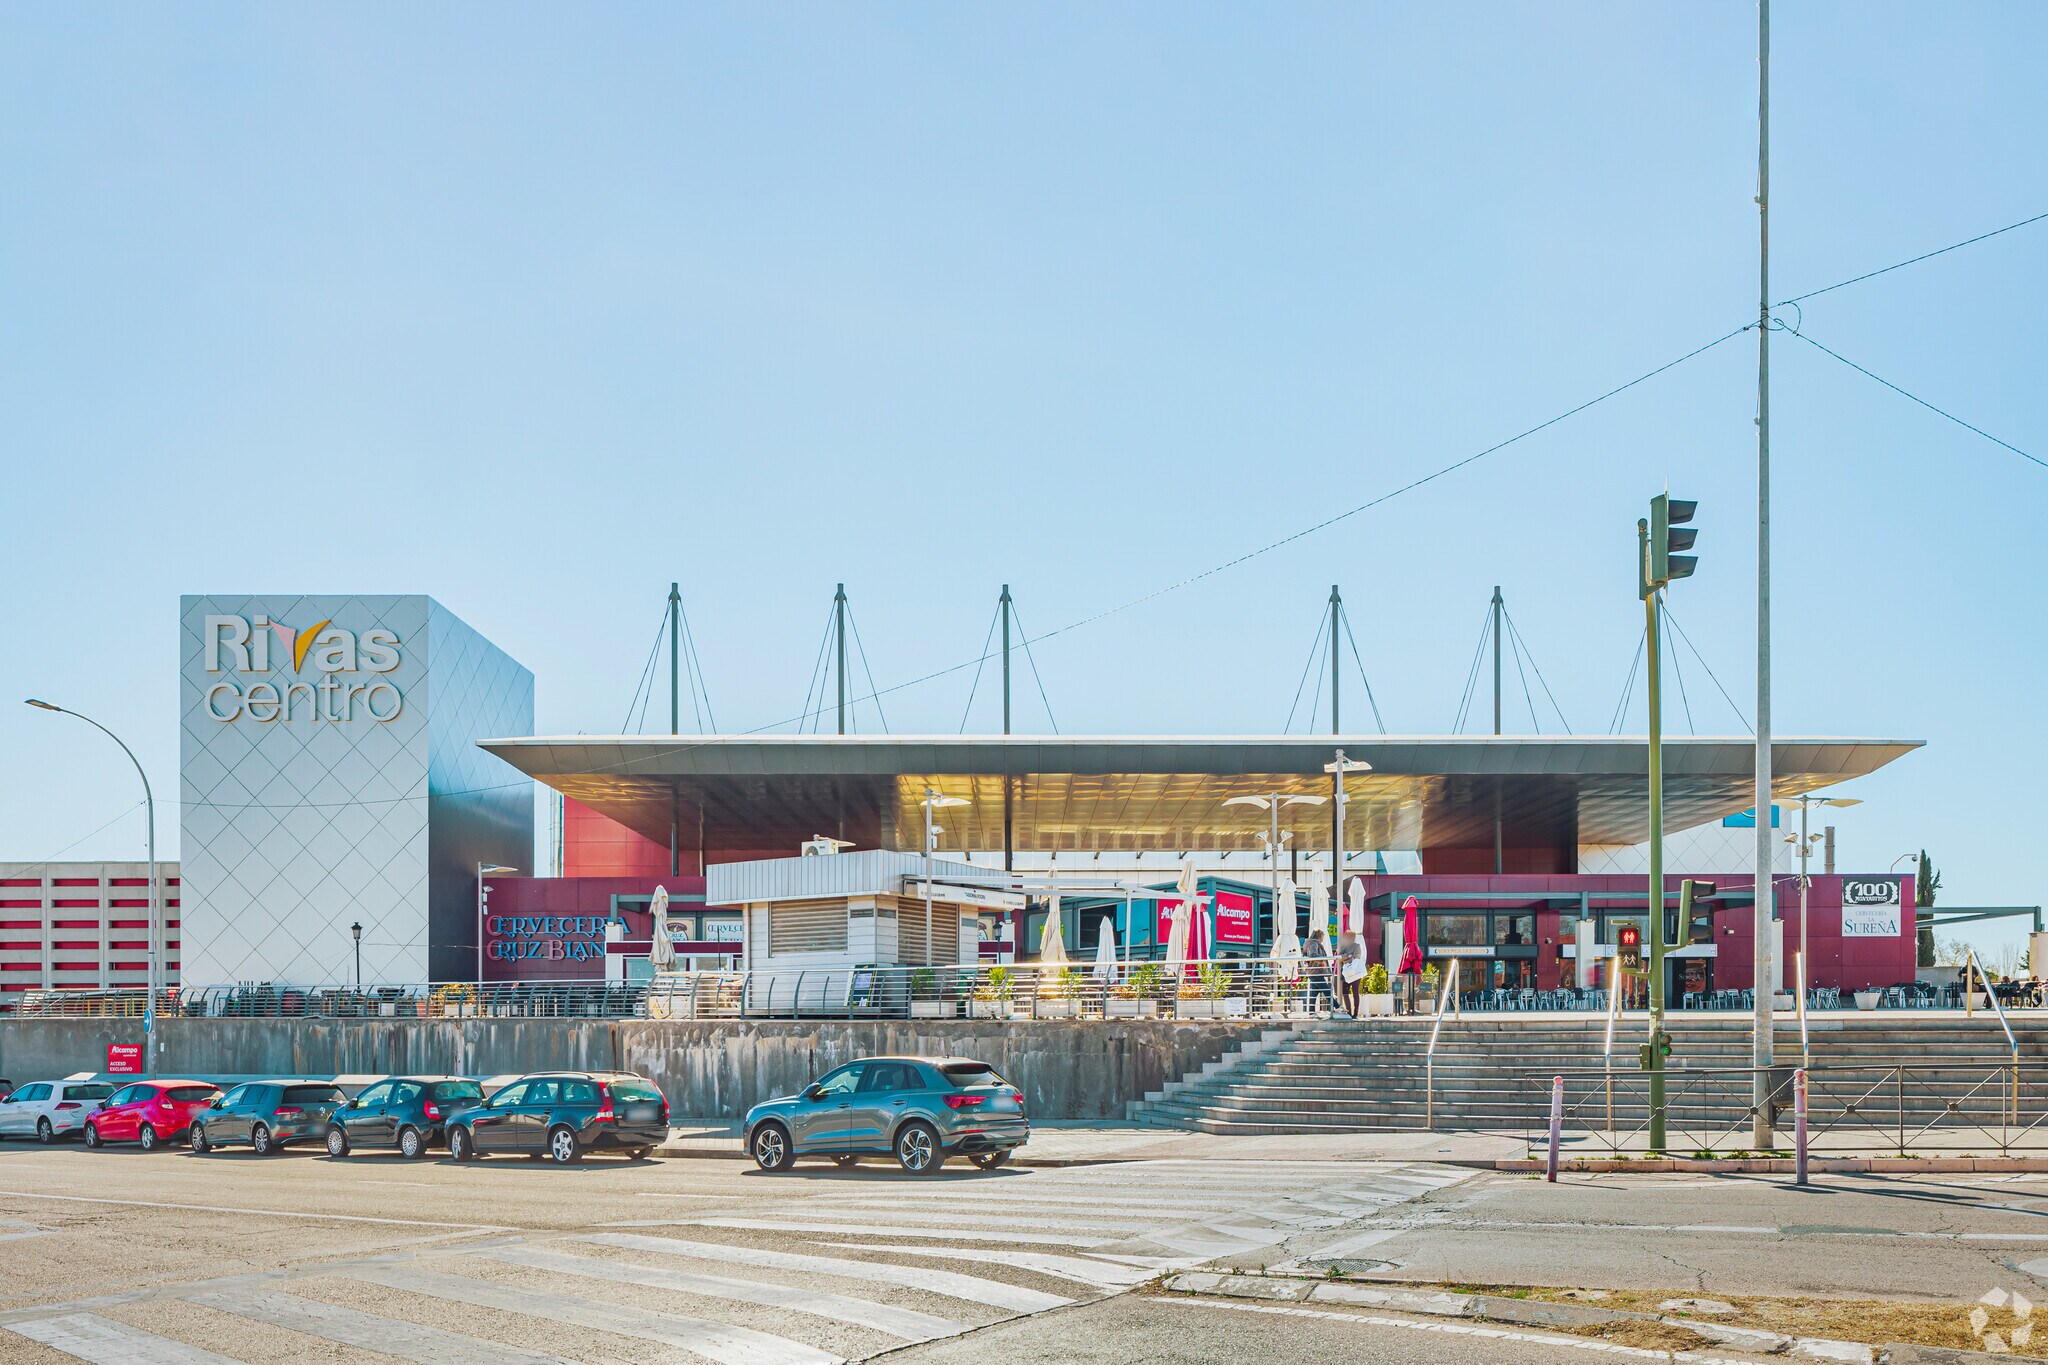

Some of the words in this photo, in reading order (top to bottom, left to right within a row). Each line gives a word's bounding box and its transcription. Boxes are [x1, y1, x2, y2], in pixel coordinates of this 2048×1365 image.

[205, 614, 401, 674] Rivas
[204, 674, 403, 722] centro
[1855, 884, 1887, 896] 100
[1217, 903, 1250, 920] Alcampo
[486, 915, 631, 938] CERVECERA
[1845, 919, 1897, 933] SUREÑA
[486, 939, 542, 963] CRUZ
[547, 939, 605, 962] BLAN
[112, 1046, 138, 1054] Alcampo
